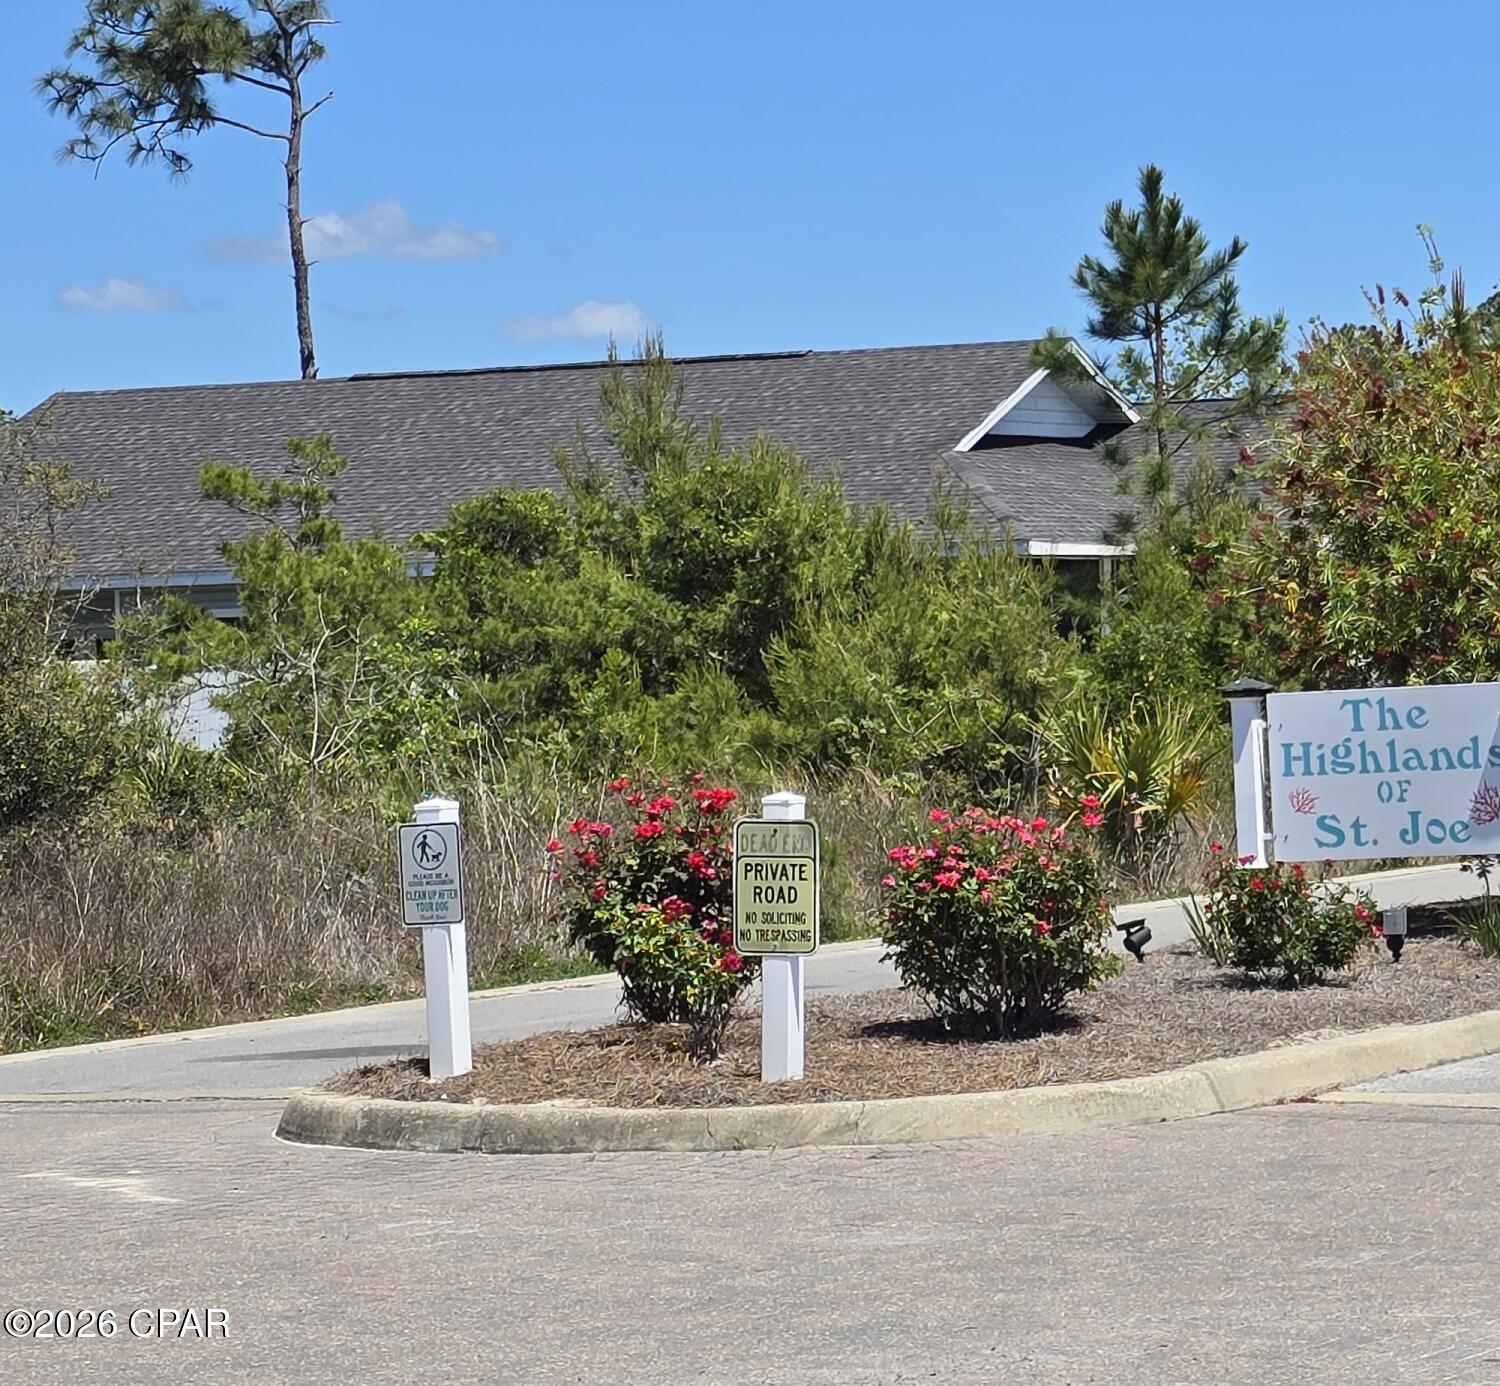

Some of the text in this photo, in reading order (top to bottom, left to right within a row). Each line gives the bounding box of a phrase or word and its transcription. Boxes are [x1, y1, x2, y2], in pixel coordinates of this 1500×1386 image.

[1340, 697, 1430, 733] The
[1376, 779, 1412, 804] OF
[1314, 810, 1472, 849] St. Joe
[740, 832, 811, 854] DEAD END
[744, 863, 808, 882] PRIVATE
[405, 889, 458, 901] CLEAN UP AFTER
[753, 886, 798, 904] ROAD
[415, 901, 449, 912] YOUR DOG
[745, 911, 807, 925] NO SOLICITING
[739, 929, 812, 943] NO TRESPASSING
